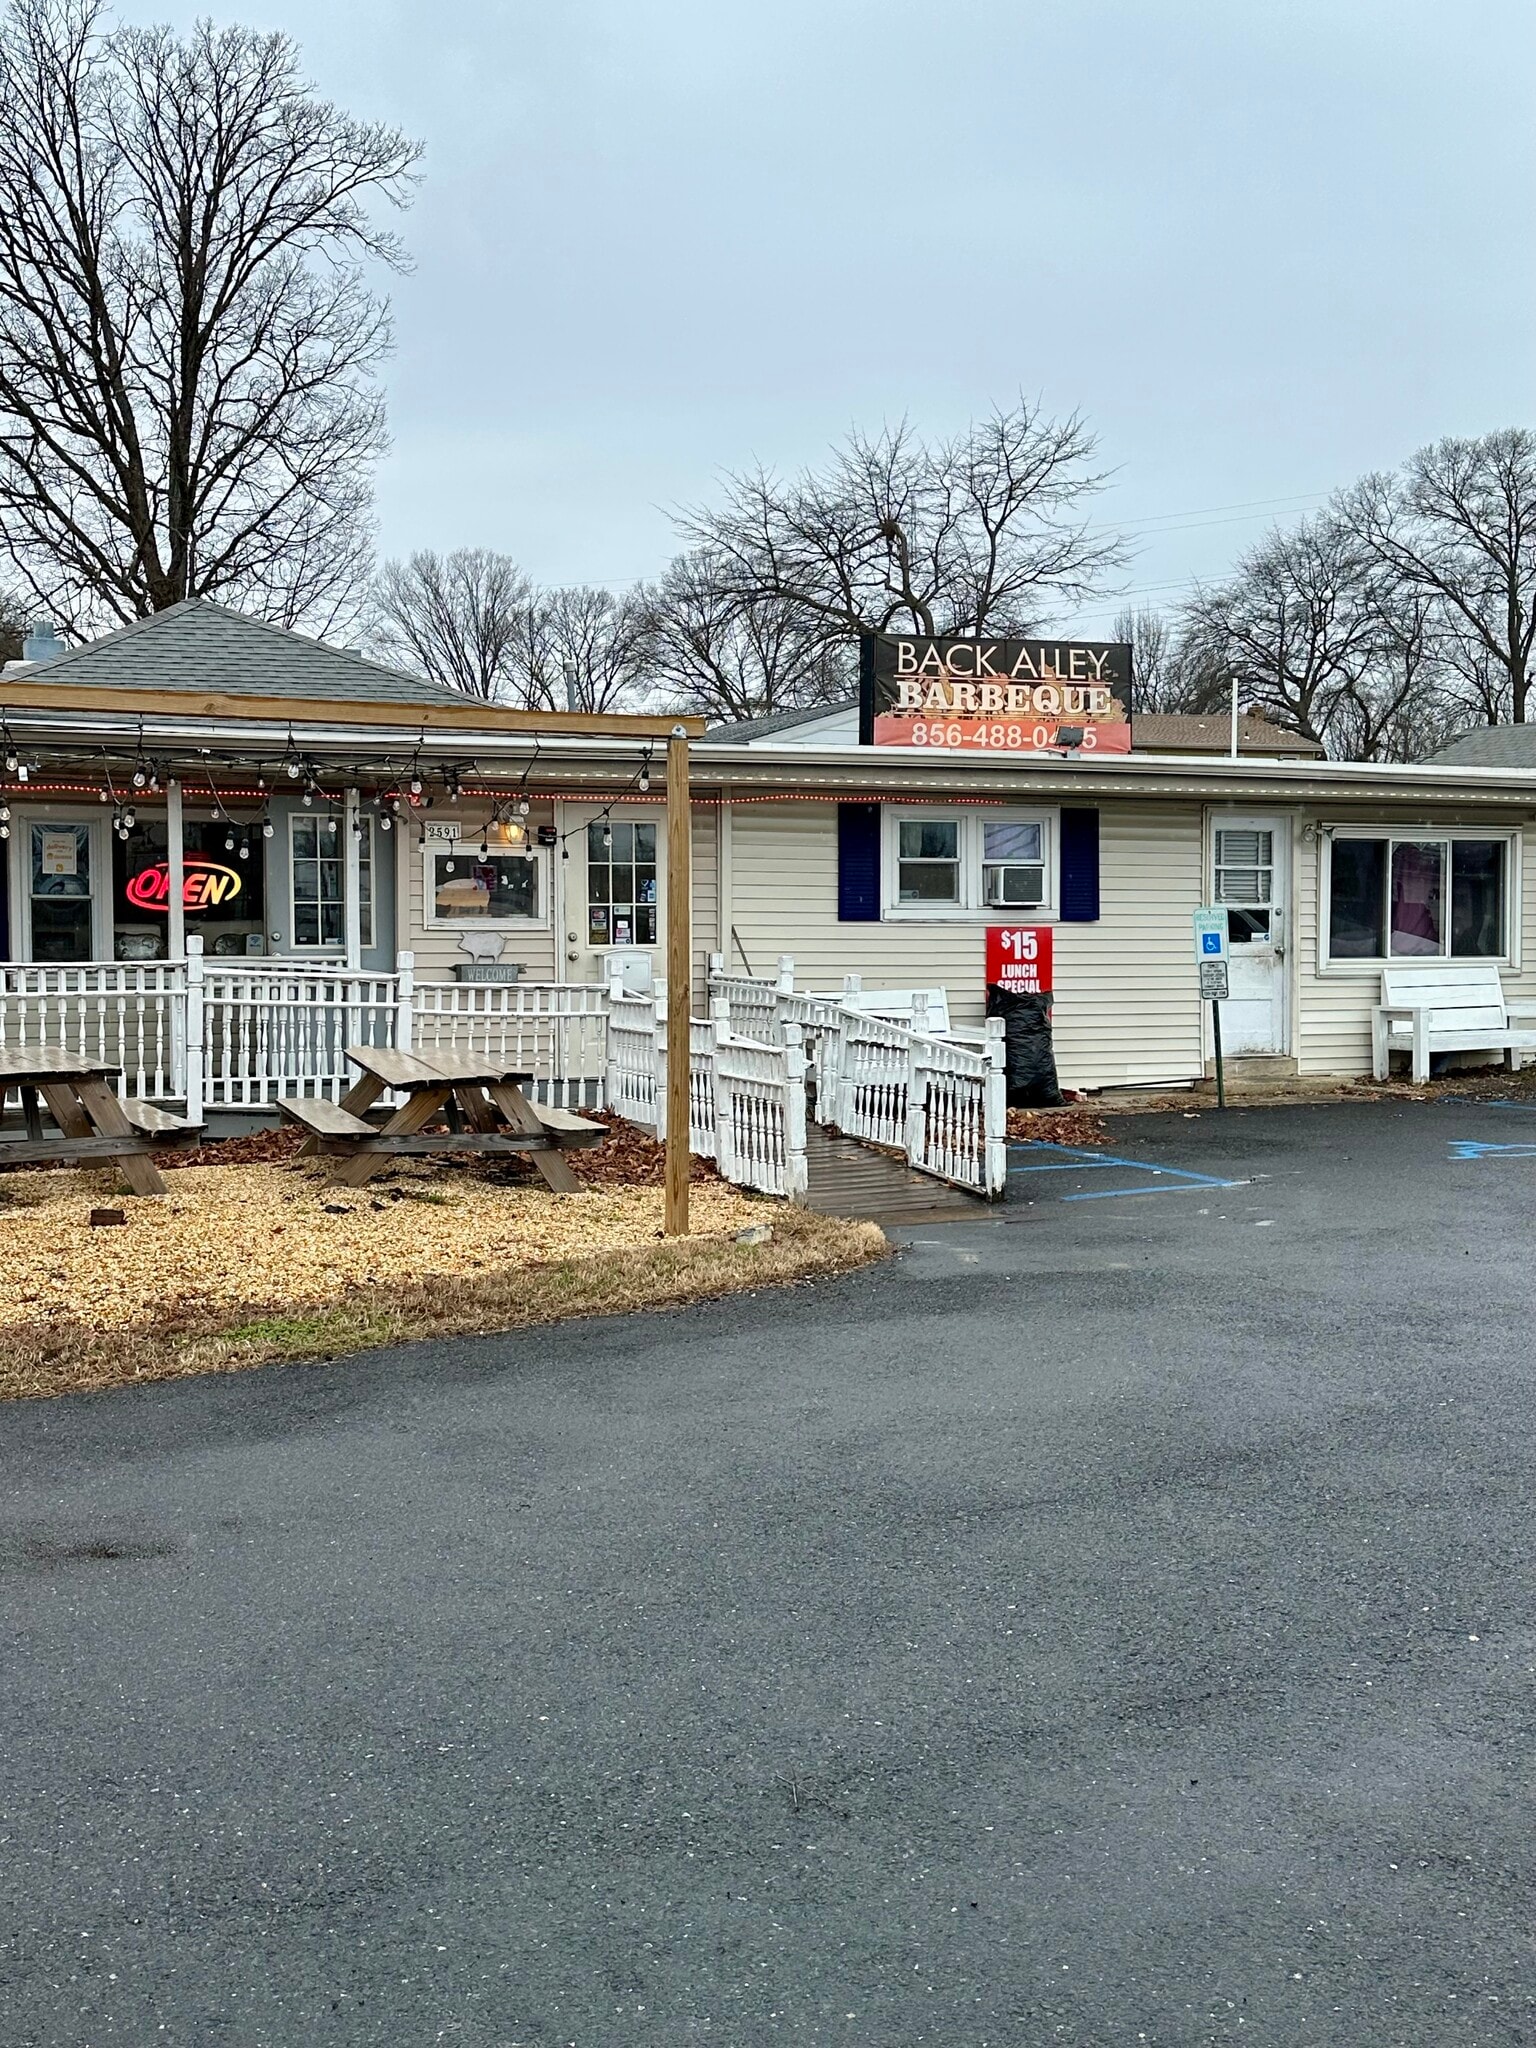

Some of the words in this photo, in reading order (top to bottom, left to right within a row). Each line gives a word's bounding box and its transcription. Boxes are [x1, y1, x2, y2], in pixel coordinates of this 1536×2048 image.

[897, 641, 999, 676] BACK
[1010, 646, 1110, 680] ALLEY
[896, 680, 1112, 715] BARBEQUE
[911, 722, 1098, 749] 856-488-05
[429, 826, 457, 838] 2591
[1001, 930, 1038, 960] $15
[467, 968, 513, 982] WELCOME
[1001, 964, 1038, 978] LUNCH
[997, 979, 1041, 994] SPECIAL
